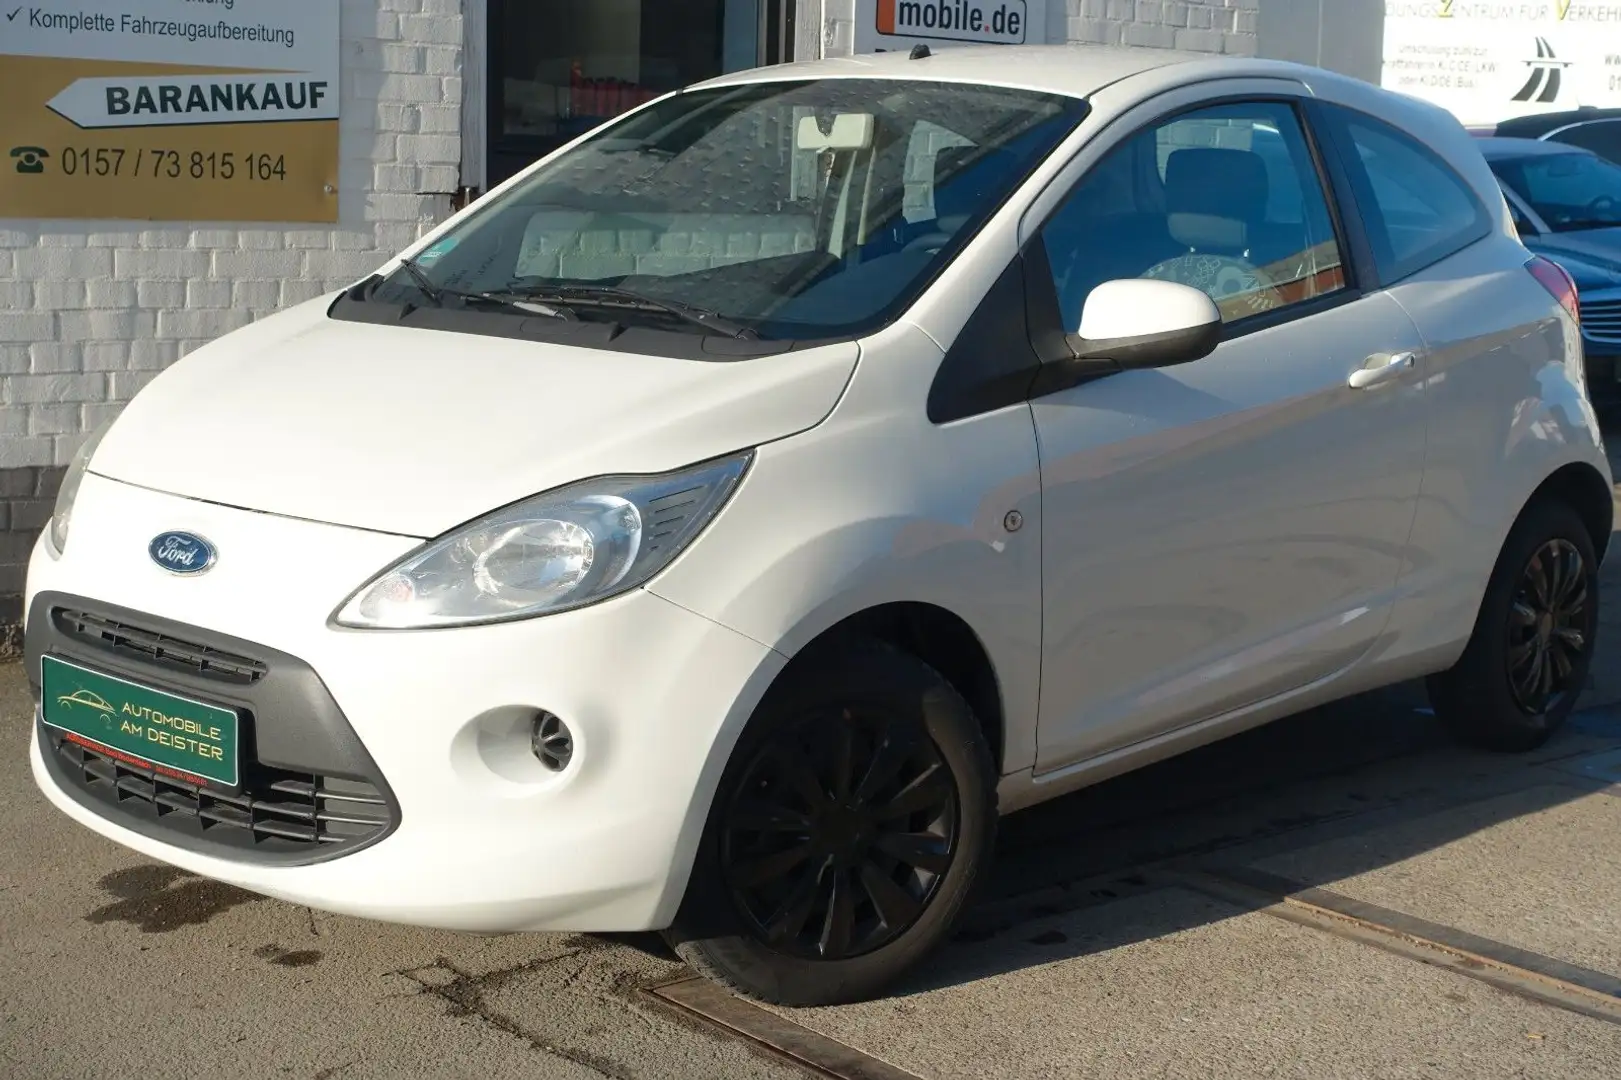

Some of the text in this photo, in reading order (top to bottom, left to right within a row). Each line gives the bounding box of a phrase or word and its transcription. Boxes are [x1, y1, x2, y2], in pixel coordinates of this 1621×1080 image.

[29, 8, 295, 47] Komplette Fahrzeugaufbereitung
[899, 0, 1020, 35] mobile.de
[105, 81, 328, 116] BARANKAUF
[61, 146, 126, 177] 0157
[150, 150, 181, 178] 73
[189, 152, 235, 179] 815
[245, 154, 286, 181] 164
[158, 535, 198, 566] Ford
[121, 701, 223, 741] AUTOMOBILE
[120, 719, 143, 738] AM
[147, 727, 223, 761] DEISTER
